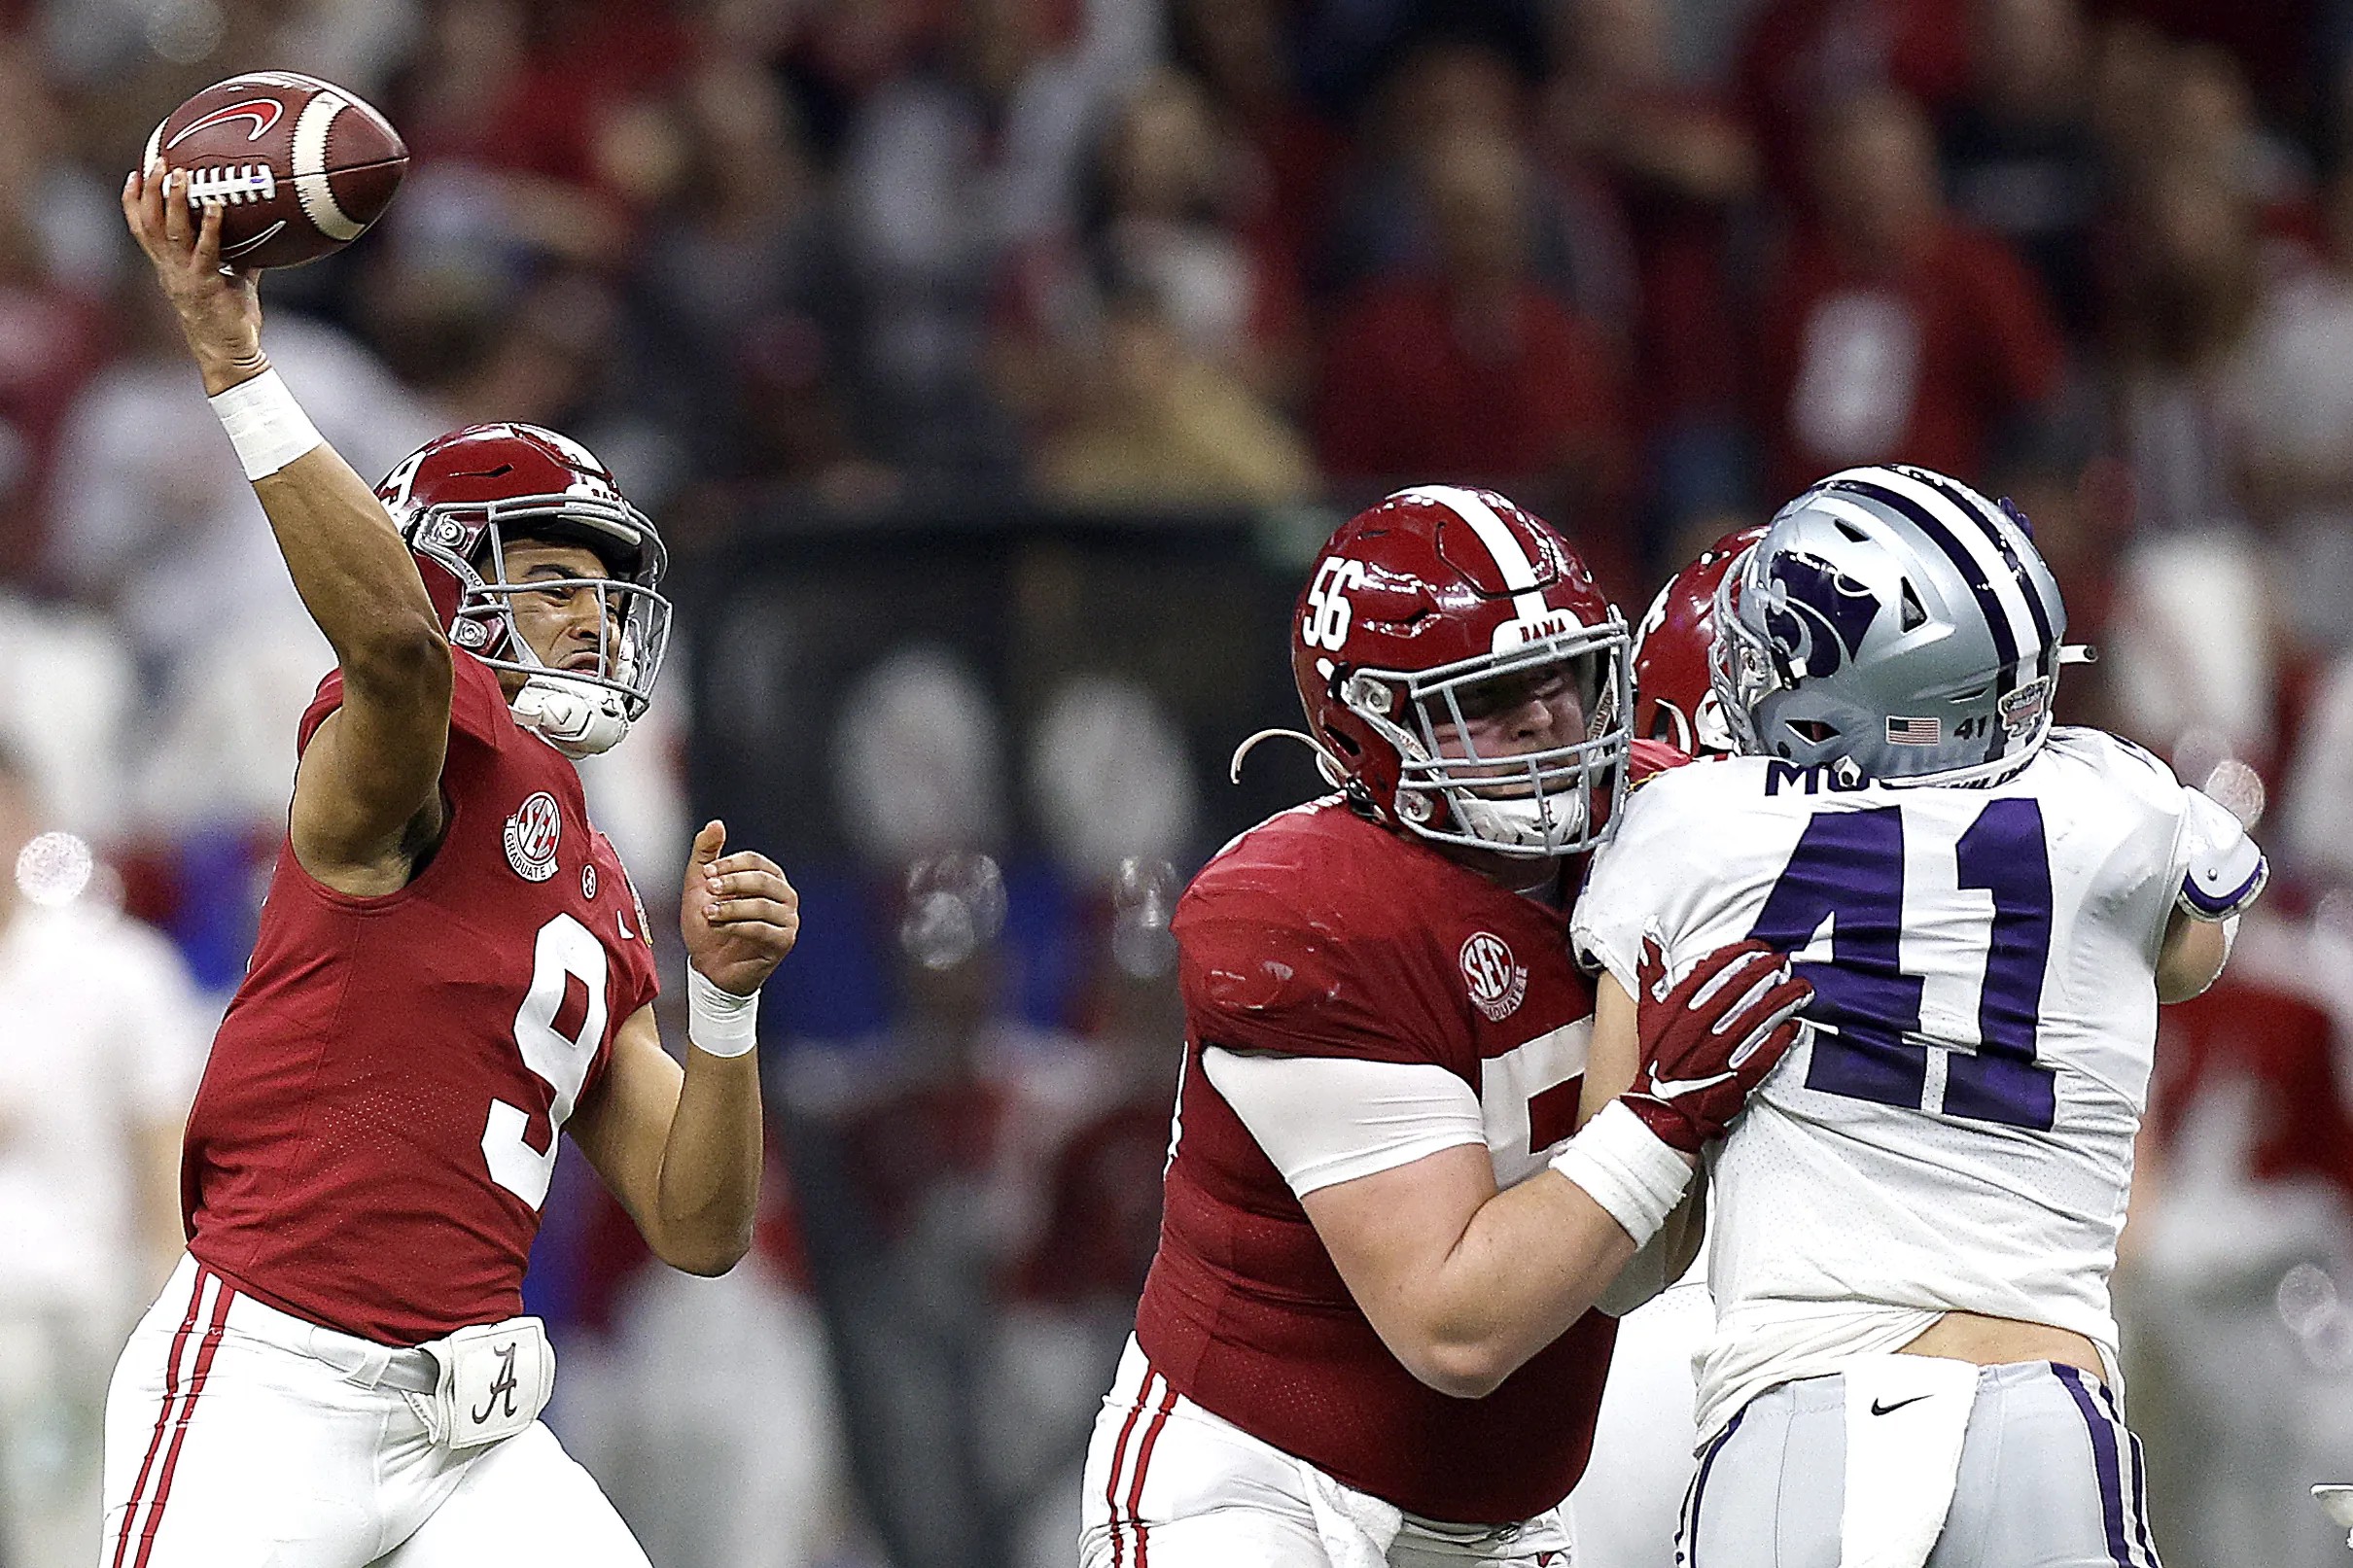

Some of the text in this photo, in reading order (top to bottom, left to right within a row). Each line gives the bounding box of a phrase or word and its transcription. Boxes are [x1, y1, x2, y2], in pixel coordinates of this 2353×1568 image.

[1303, 556, 1366, 651] 56
[1953, 715, 1987, 740] 41
[505, 831, 546, 879] GRADUATE
[517, 796, 558, 859] SEC
[1464, 937, 1511, 999] SEC
[1746, 798, 2056, 1132] 41
[481, 912, 608, 1212] 9
[472, 1342, 518, 1425] A
